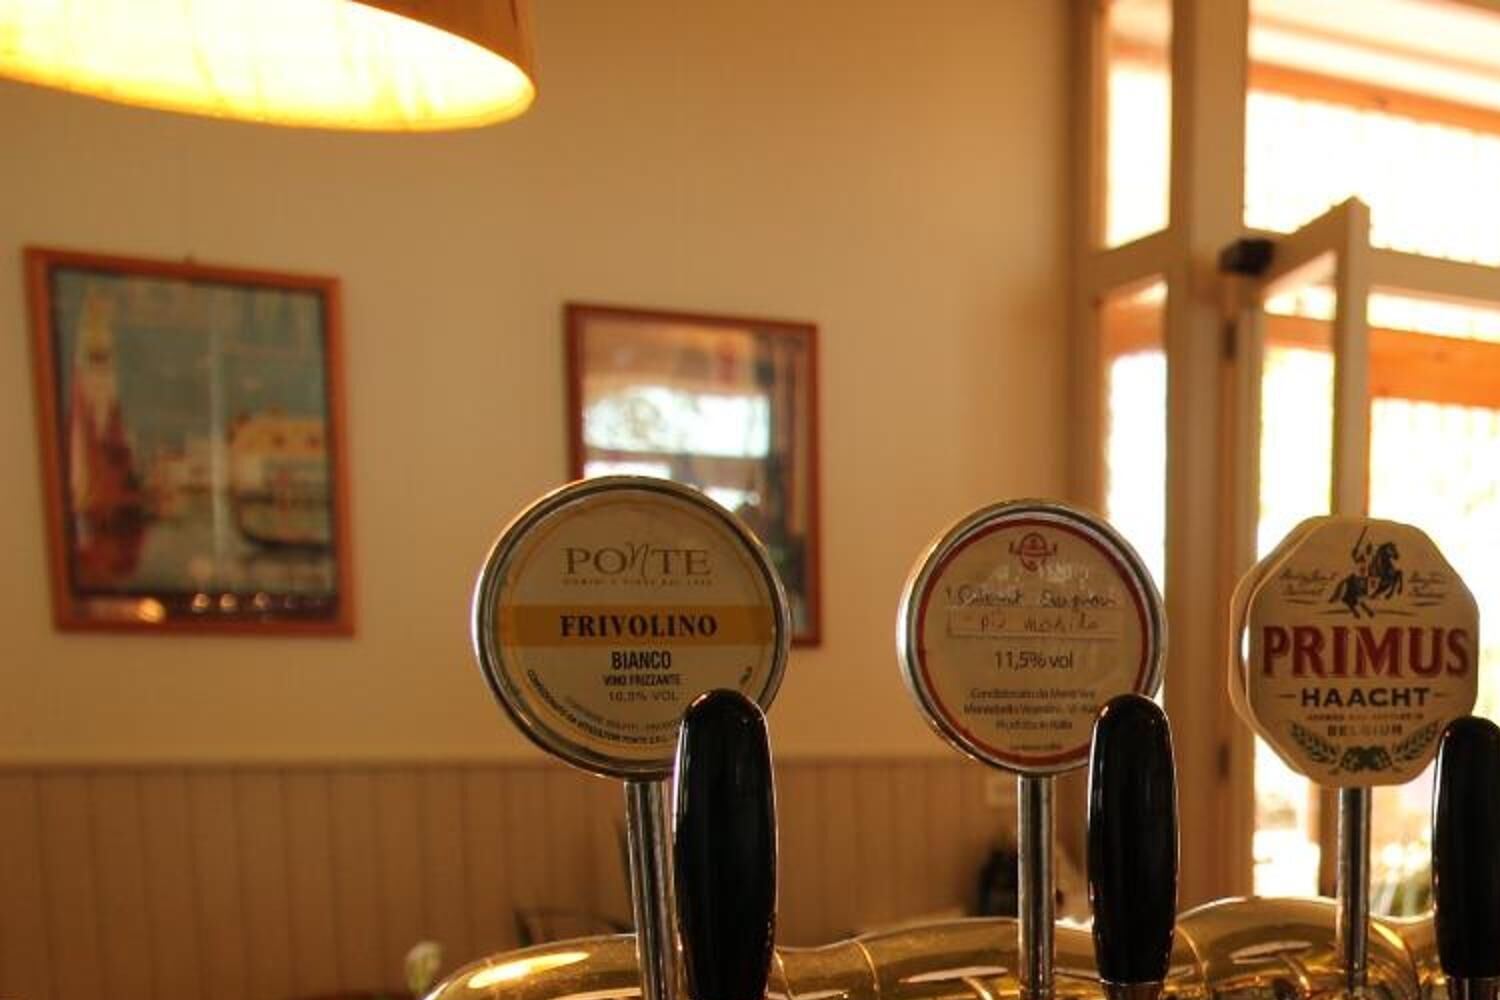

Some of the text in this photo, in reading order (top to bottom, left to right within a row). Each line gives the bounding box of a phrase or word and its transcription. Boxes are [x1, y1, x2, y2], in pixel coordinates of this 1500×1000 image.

[565, 541, 712, 577] PONTE
[560, 615, 718, 637] FRIVOLINO
[611, 651, 672, 670] BIANCO
[995, 651, 1074, 671] 11,5% vol
[1262, 624, 1470, 679] PRIMUS
[604, 674, 681, 686] VINO FRIZZANTE
[1301, 688, 1430, 707] HAACHT
[1327, 724, 1403, 737] BELGIUM
